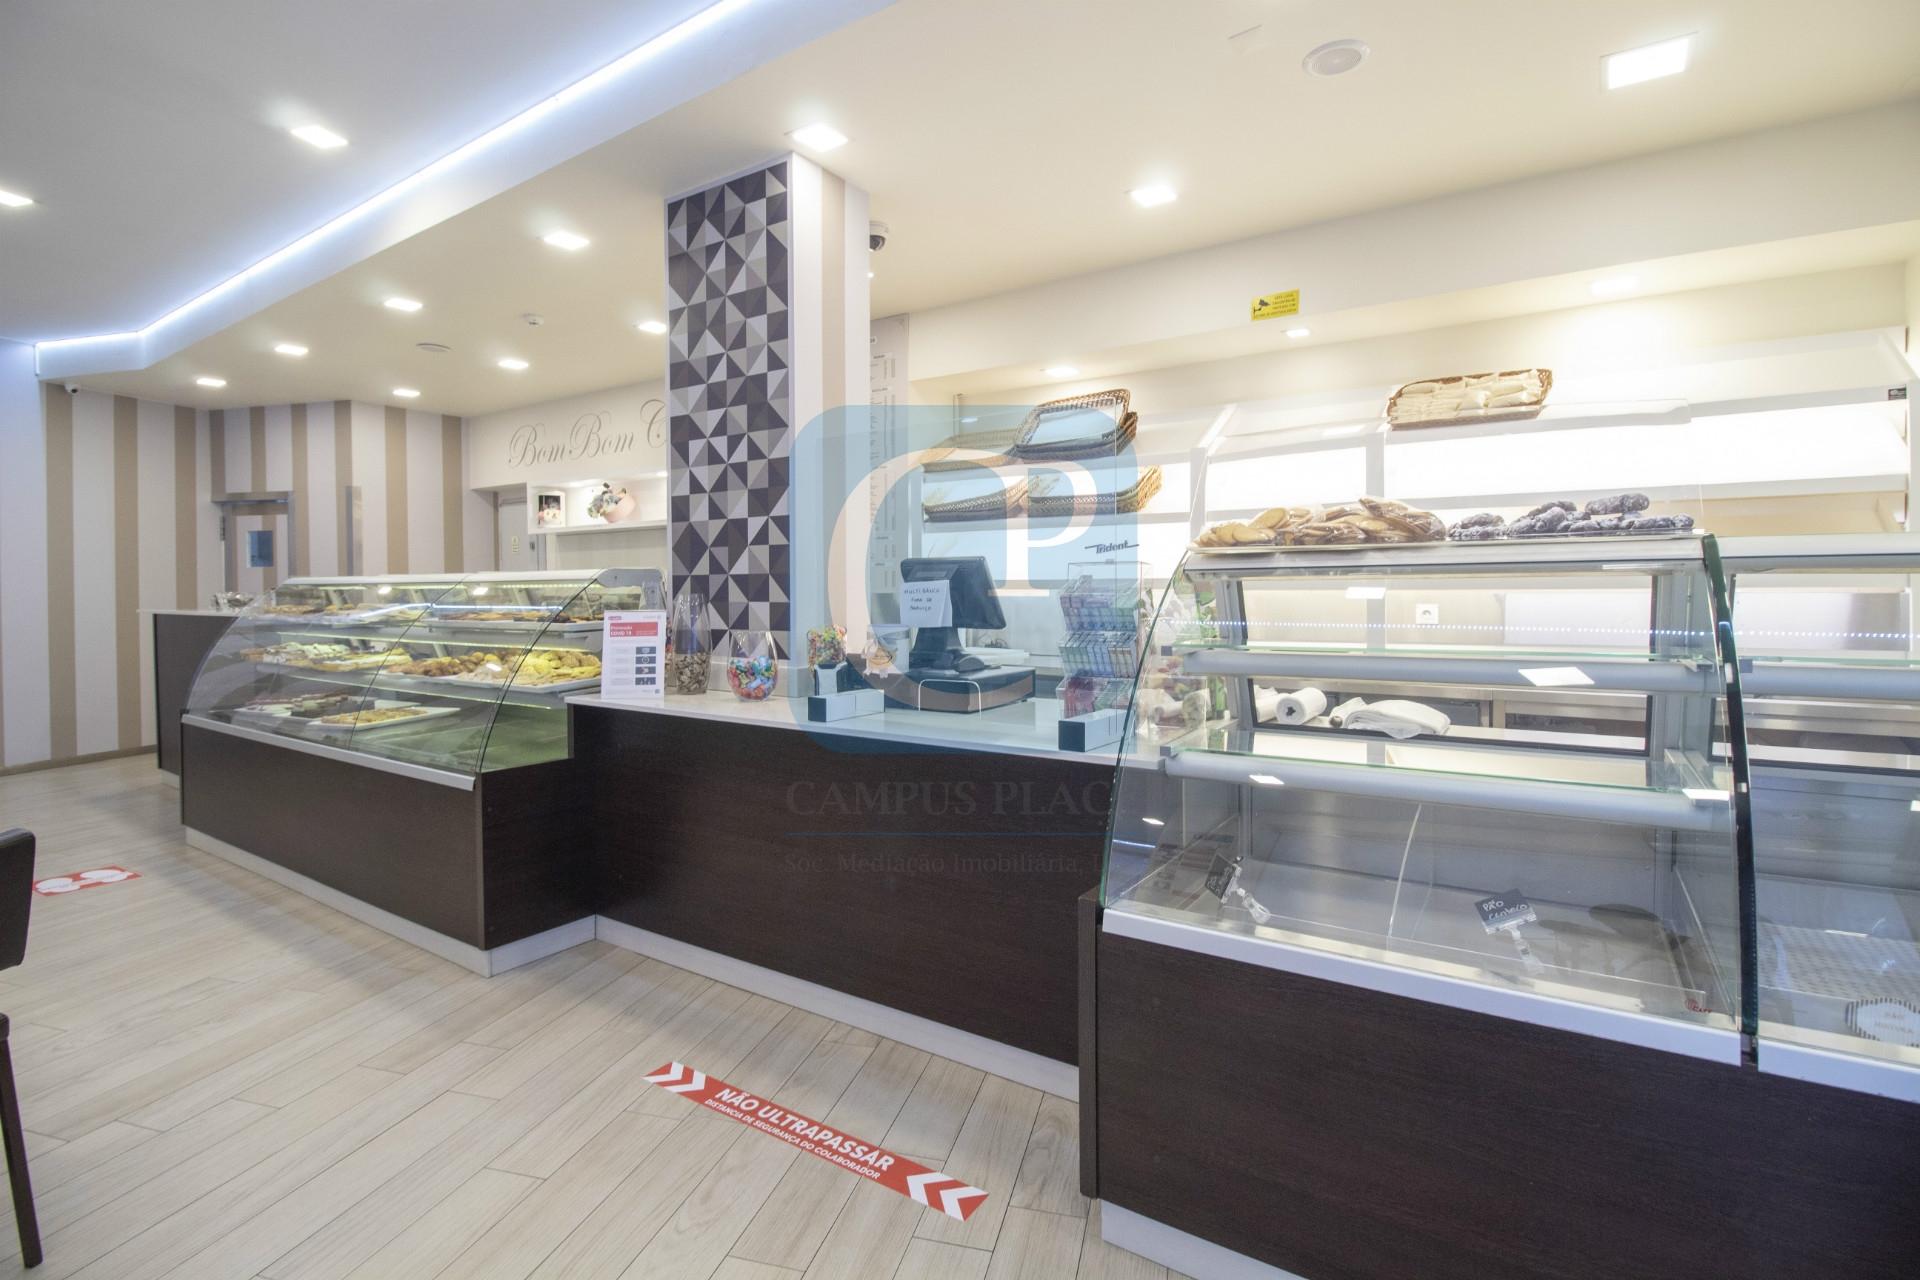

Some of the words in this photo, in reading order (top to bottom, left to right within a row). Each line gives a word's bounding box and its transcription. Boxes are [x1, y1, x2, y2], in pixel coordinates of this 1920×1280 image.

[508, 422, 566, 470] Bom
[568, 411, 634, 461] Bom
[1090, 539, 1134, 554] Trident
[1482, 899, 1504, 912] PÃO
[715, 1088, 759, 1111] NÃO
[757, 1105, 895, 1171] ULTRAPASSAR
[742, 1115, 755, 1123] DE
[800, 1140, 815, 1150] DO
[814, 1147, 881, 1180] COLABORADOR
